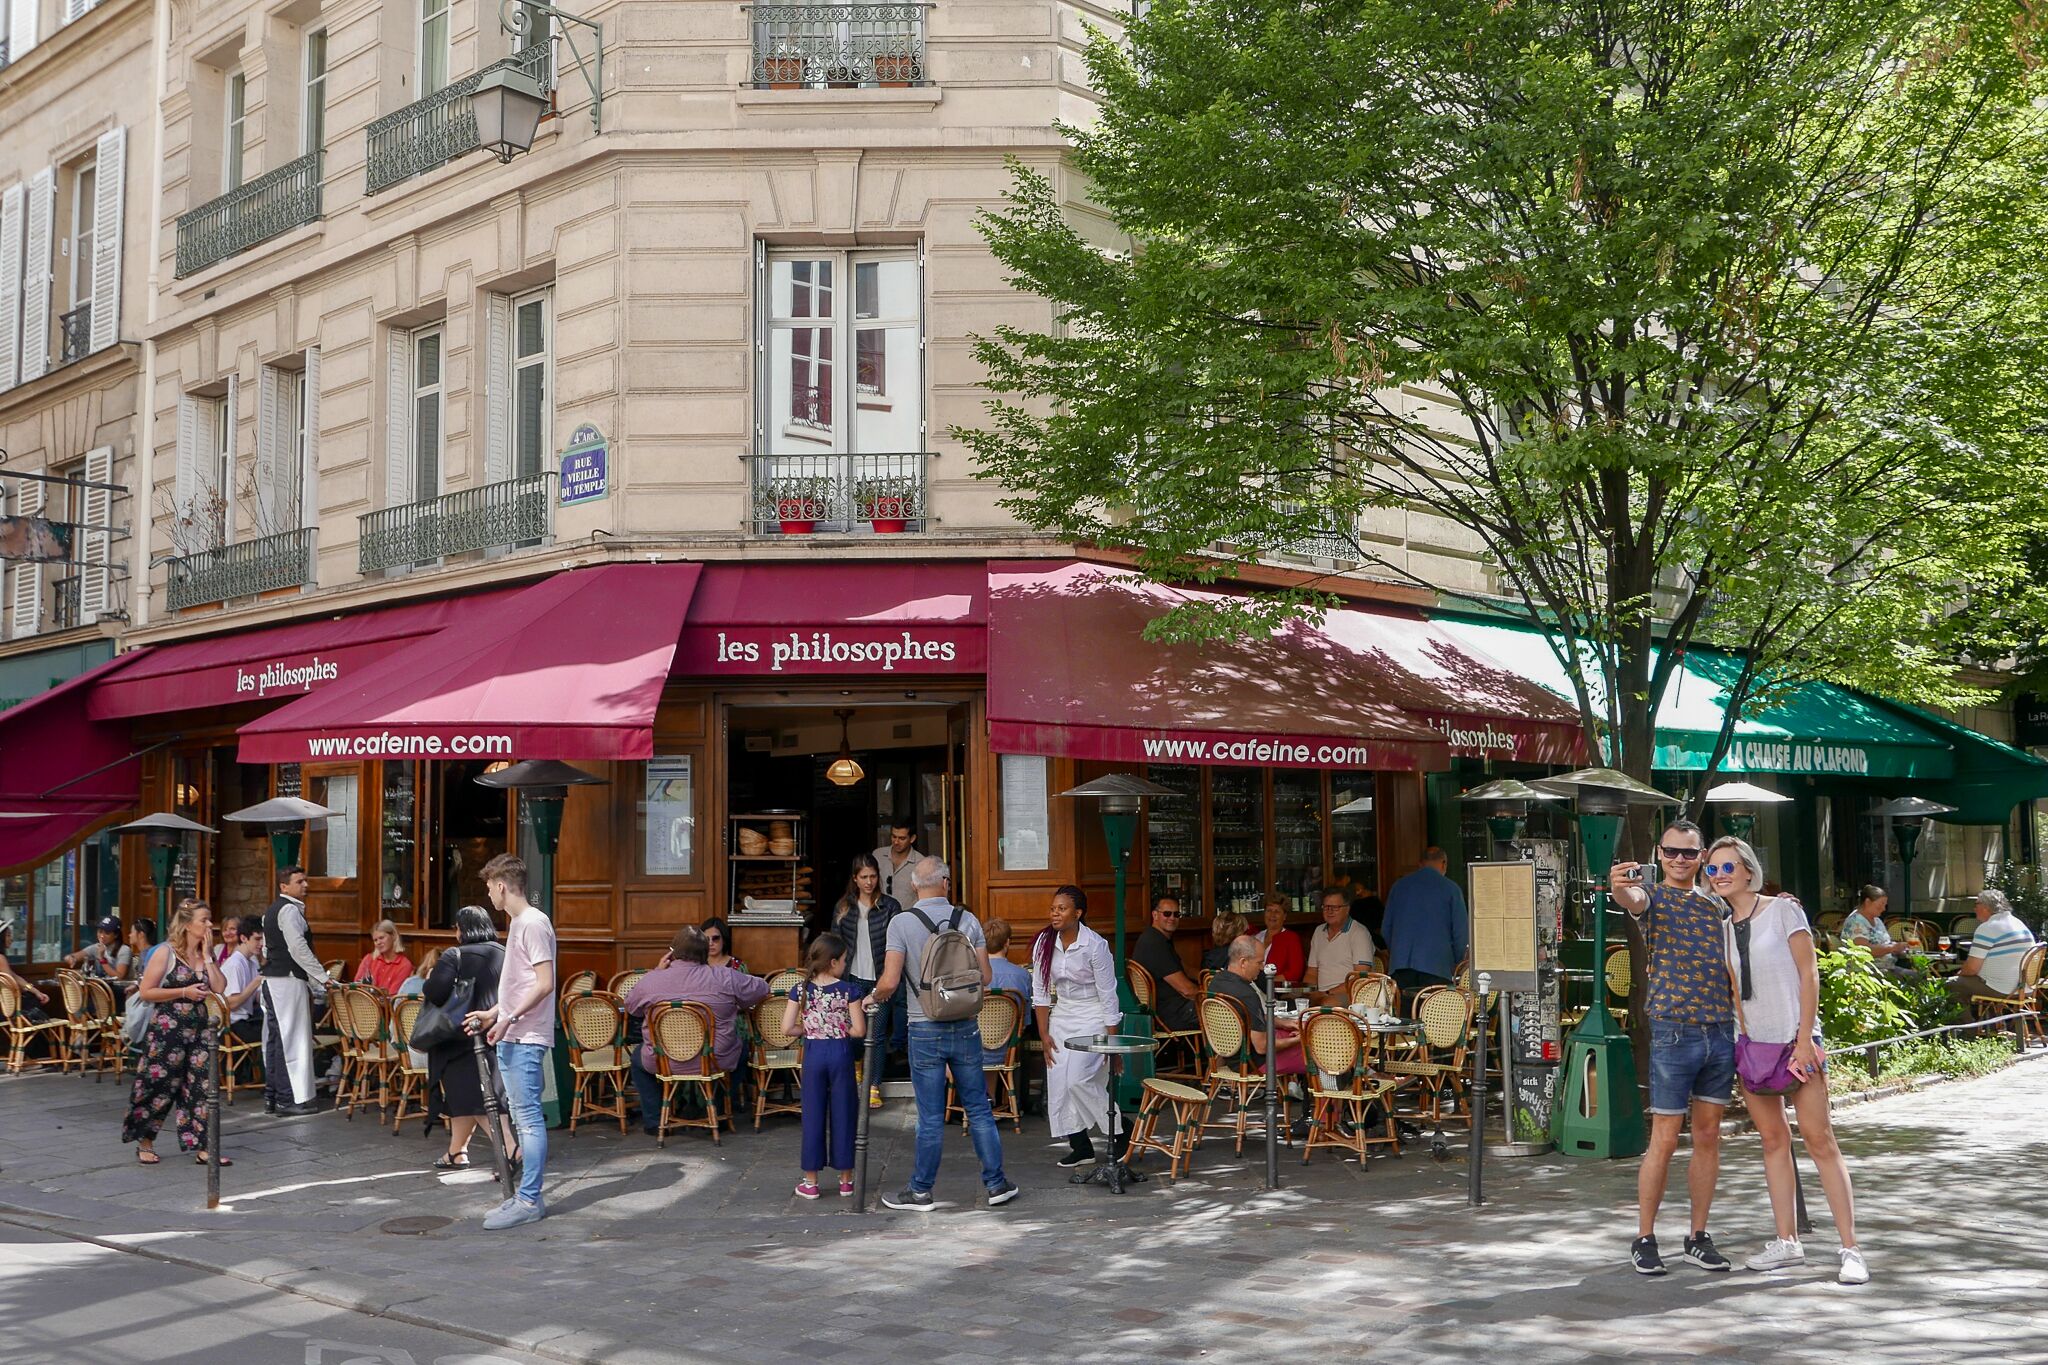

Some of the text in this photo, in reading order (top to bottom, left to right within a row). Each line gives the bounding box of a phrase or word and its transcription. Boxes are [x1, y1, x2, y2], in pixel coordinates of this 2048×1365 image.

[575, 456, 592, 469] RUE
[567, 468, 599, 483] VIEILLE
[561, 479, 605, 499] DU TEMPLE
[717, 631, 956, 671] les philosophes
[236, 656, 338, 696] les philosophes
[308, 731, 512, 756] www.cafeine.com
[1143, 738, 1367, 764] www.cafeine.com
[1727, 741, 1868, 774] LA CHAISE AU PLAFOND
